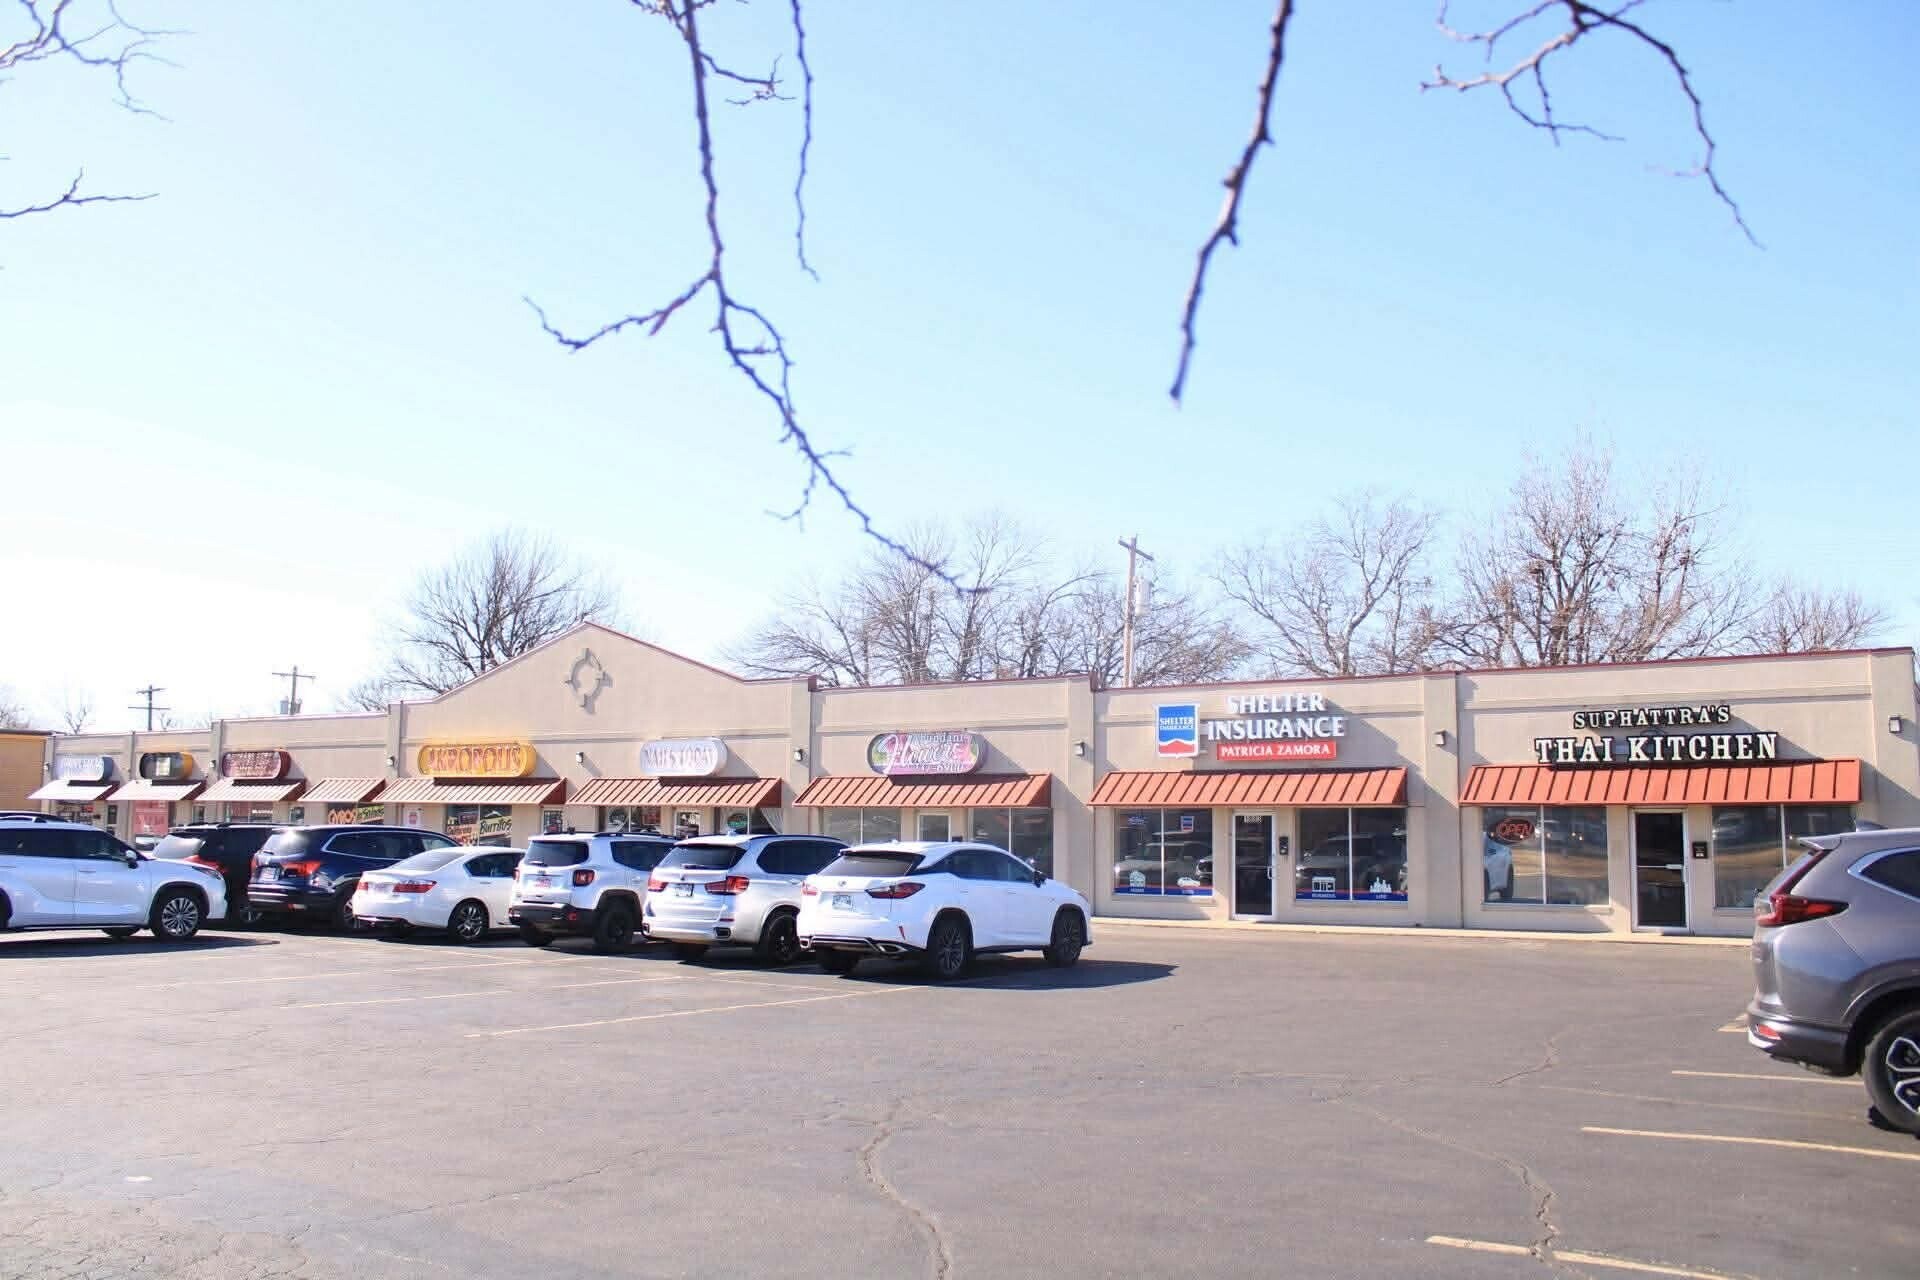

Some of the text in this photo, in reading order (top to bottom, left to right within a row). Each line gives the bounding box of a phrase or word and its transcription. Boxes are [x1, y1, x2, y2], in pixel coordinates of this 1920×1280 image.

[1226, 692, 1326, 714] SHELTER
[1159, 716, 1194, 725] SHELTER
[1207, 716, 1344, 741] INSURANCE
[1574, 705, 1730, 729] SUPHATTRA'S
[1221, 744, 1331, 757] PATRICIA ZAMORA
[1535, 732, 1778, 763] THAI KITCHEN
